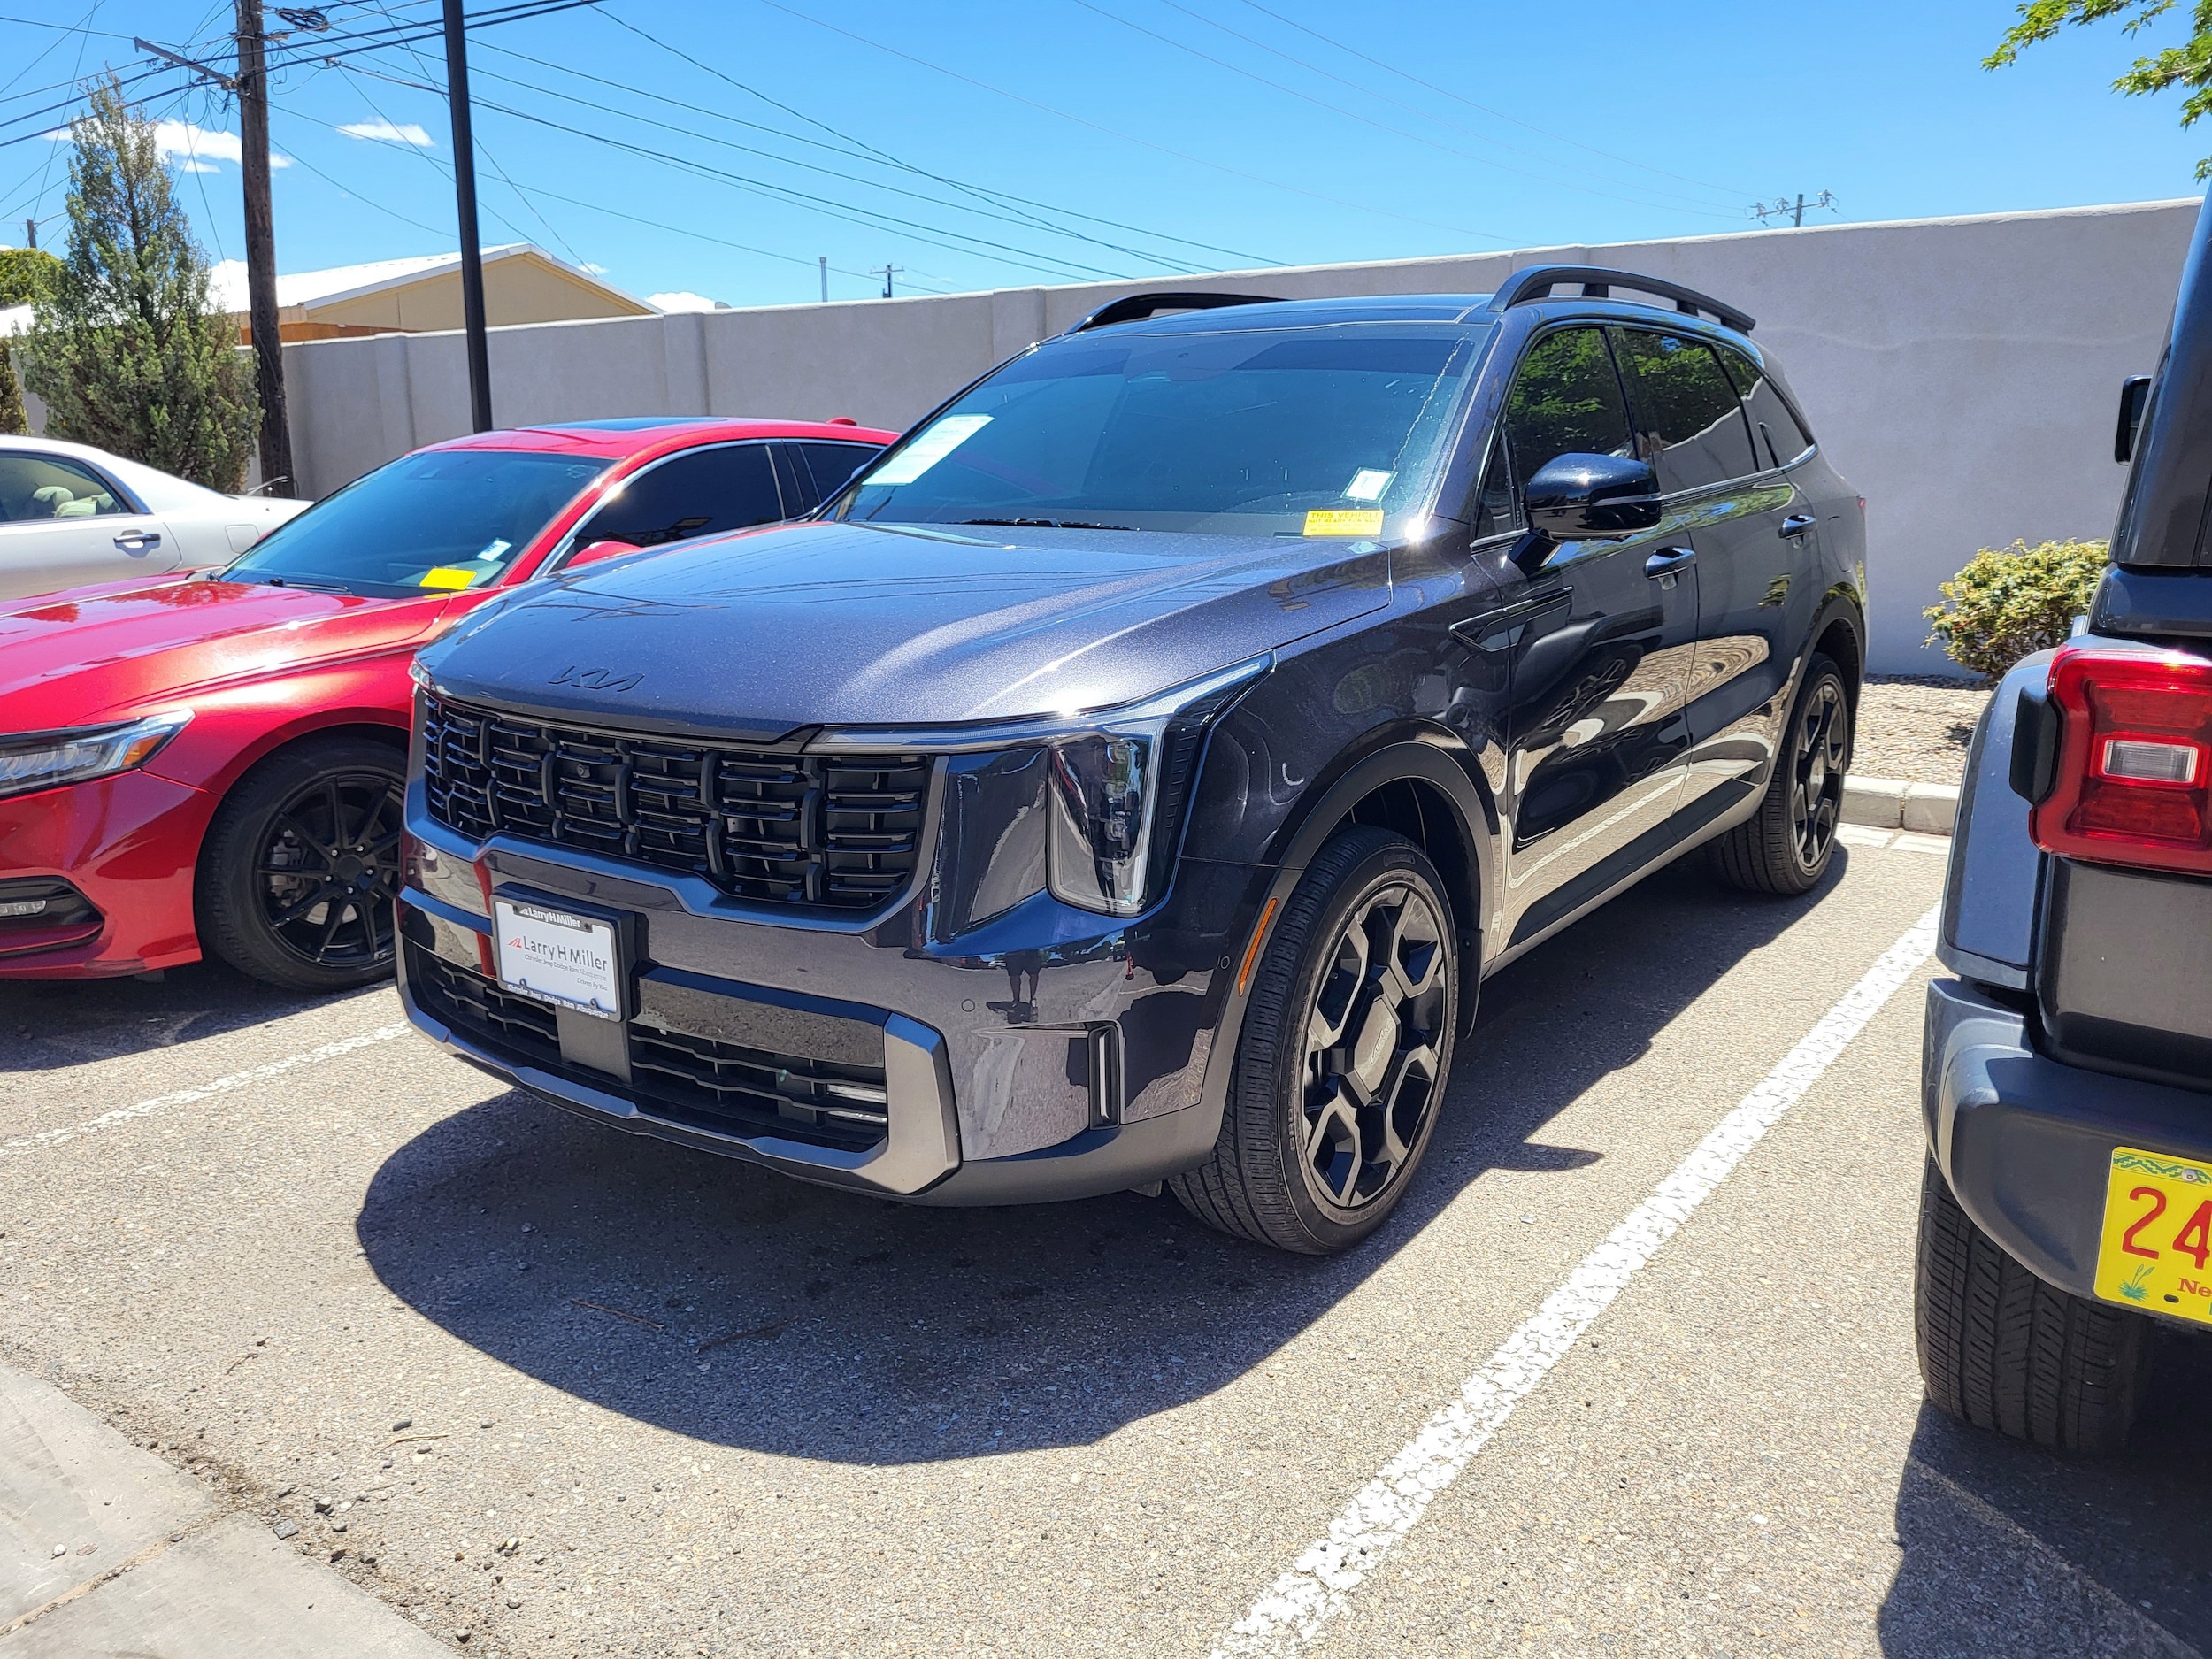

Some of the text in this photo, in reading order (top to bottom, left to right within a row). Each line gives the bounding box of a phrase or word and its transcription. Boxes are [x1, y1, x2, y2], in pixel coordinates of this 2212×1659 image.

[548, 665, 645, 692] KIA
[523, 935, 608, 972] Larry H Miller
[554, 961, 568, 972] Dodge
[577, 977, 592, 987] Driven
[593, 981, 599, 990] By
[507, 984, 528, 996] Chrysler
[530, 990, 542, 1001] Jeep
[544, 994, 561, 1006] Dodge
[563, 1000, 575, 1010] Ram
